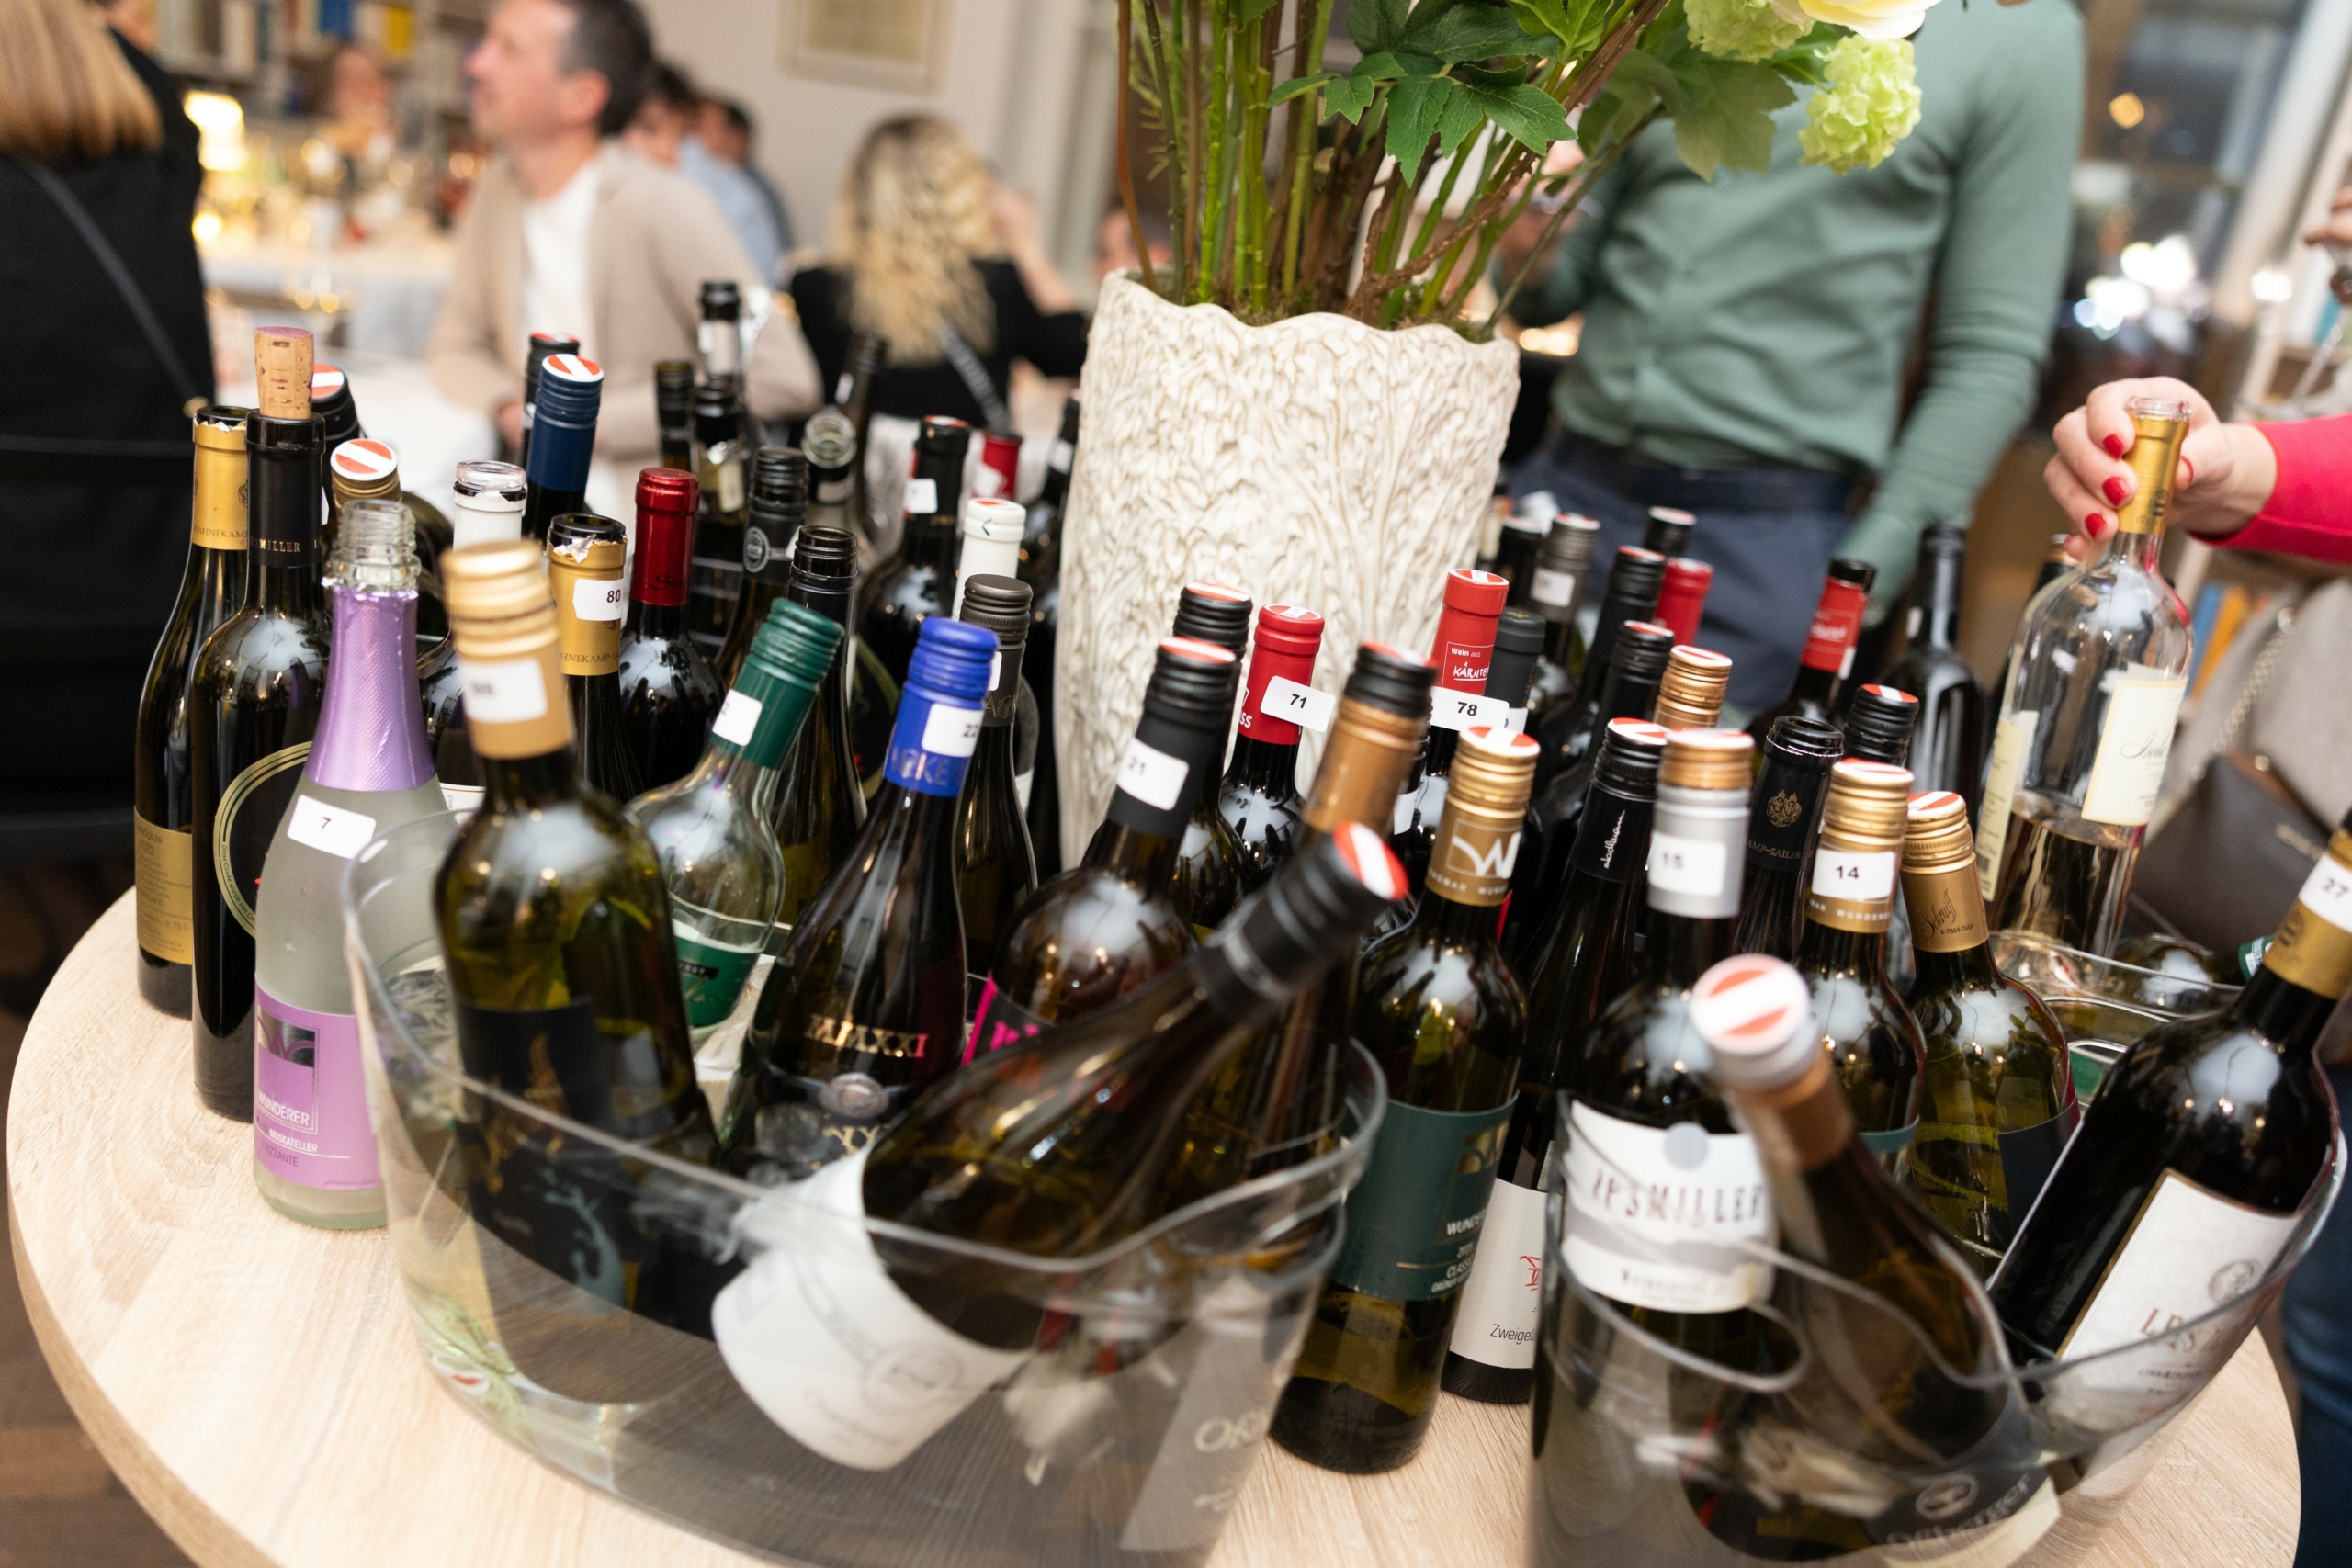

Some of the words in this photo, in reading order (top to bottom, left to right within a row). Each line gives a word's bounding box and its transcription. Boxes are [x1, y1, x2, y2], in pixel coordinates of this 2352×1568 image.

[606, 588, 621, 603] 80
[1451, 647, 1469, 657] Wein
[1290, 693, 1307, 709] 71
[1457, 701, 1478, 716] 78
[1128, 756, 1147, 776] 21
[322, 817, 332, 829] 7
[1746, 839, 1801, 861] AMP-SAILER
[1661, 851, 1683, 870] 15
[1836, 865, 1860, 880] 14
[2322, 877, 2349, 898] 27
[229, 883, 241, 902] wurde
[239, 902, 248, 914] von
[257, 1089, 311, 1127] WUNDERER
[269, 1127, 318, 1154] MUSKATELLER
